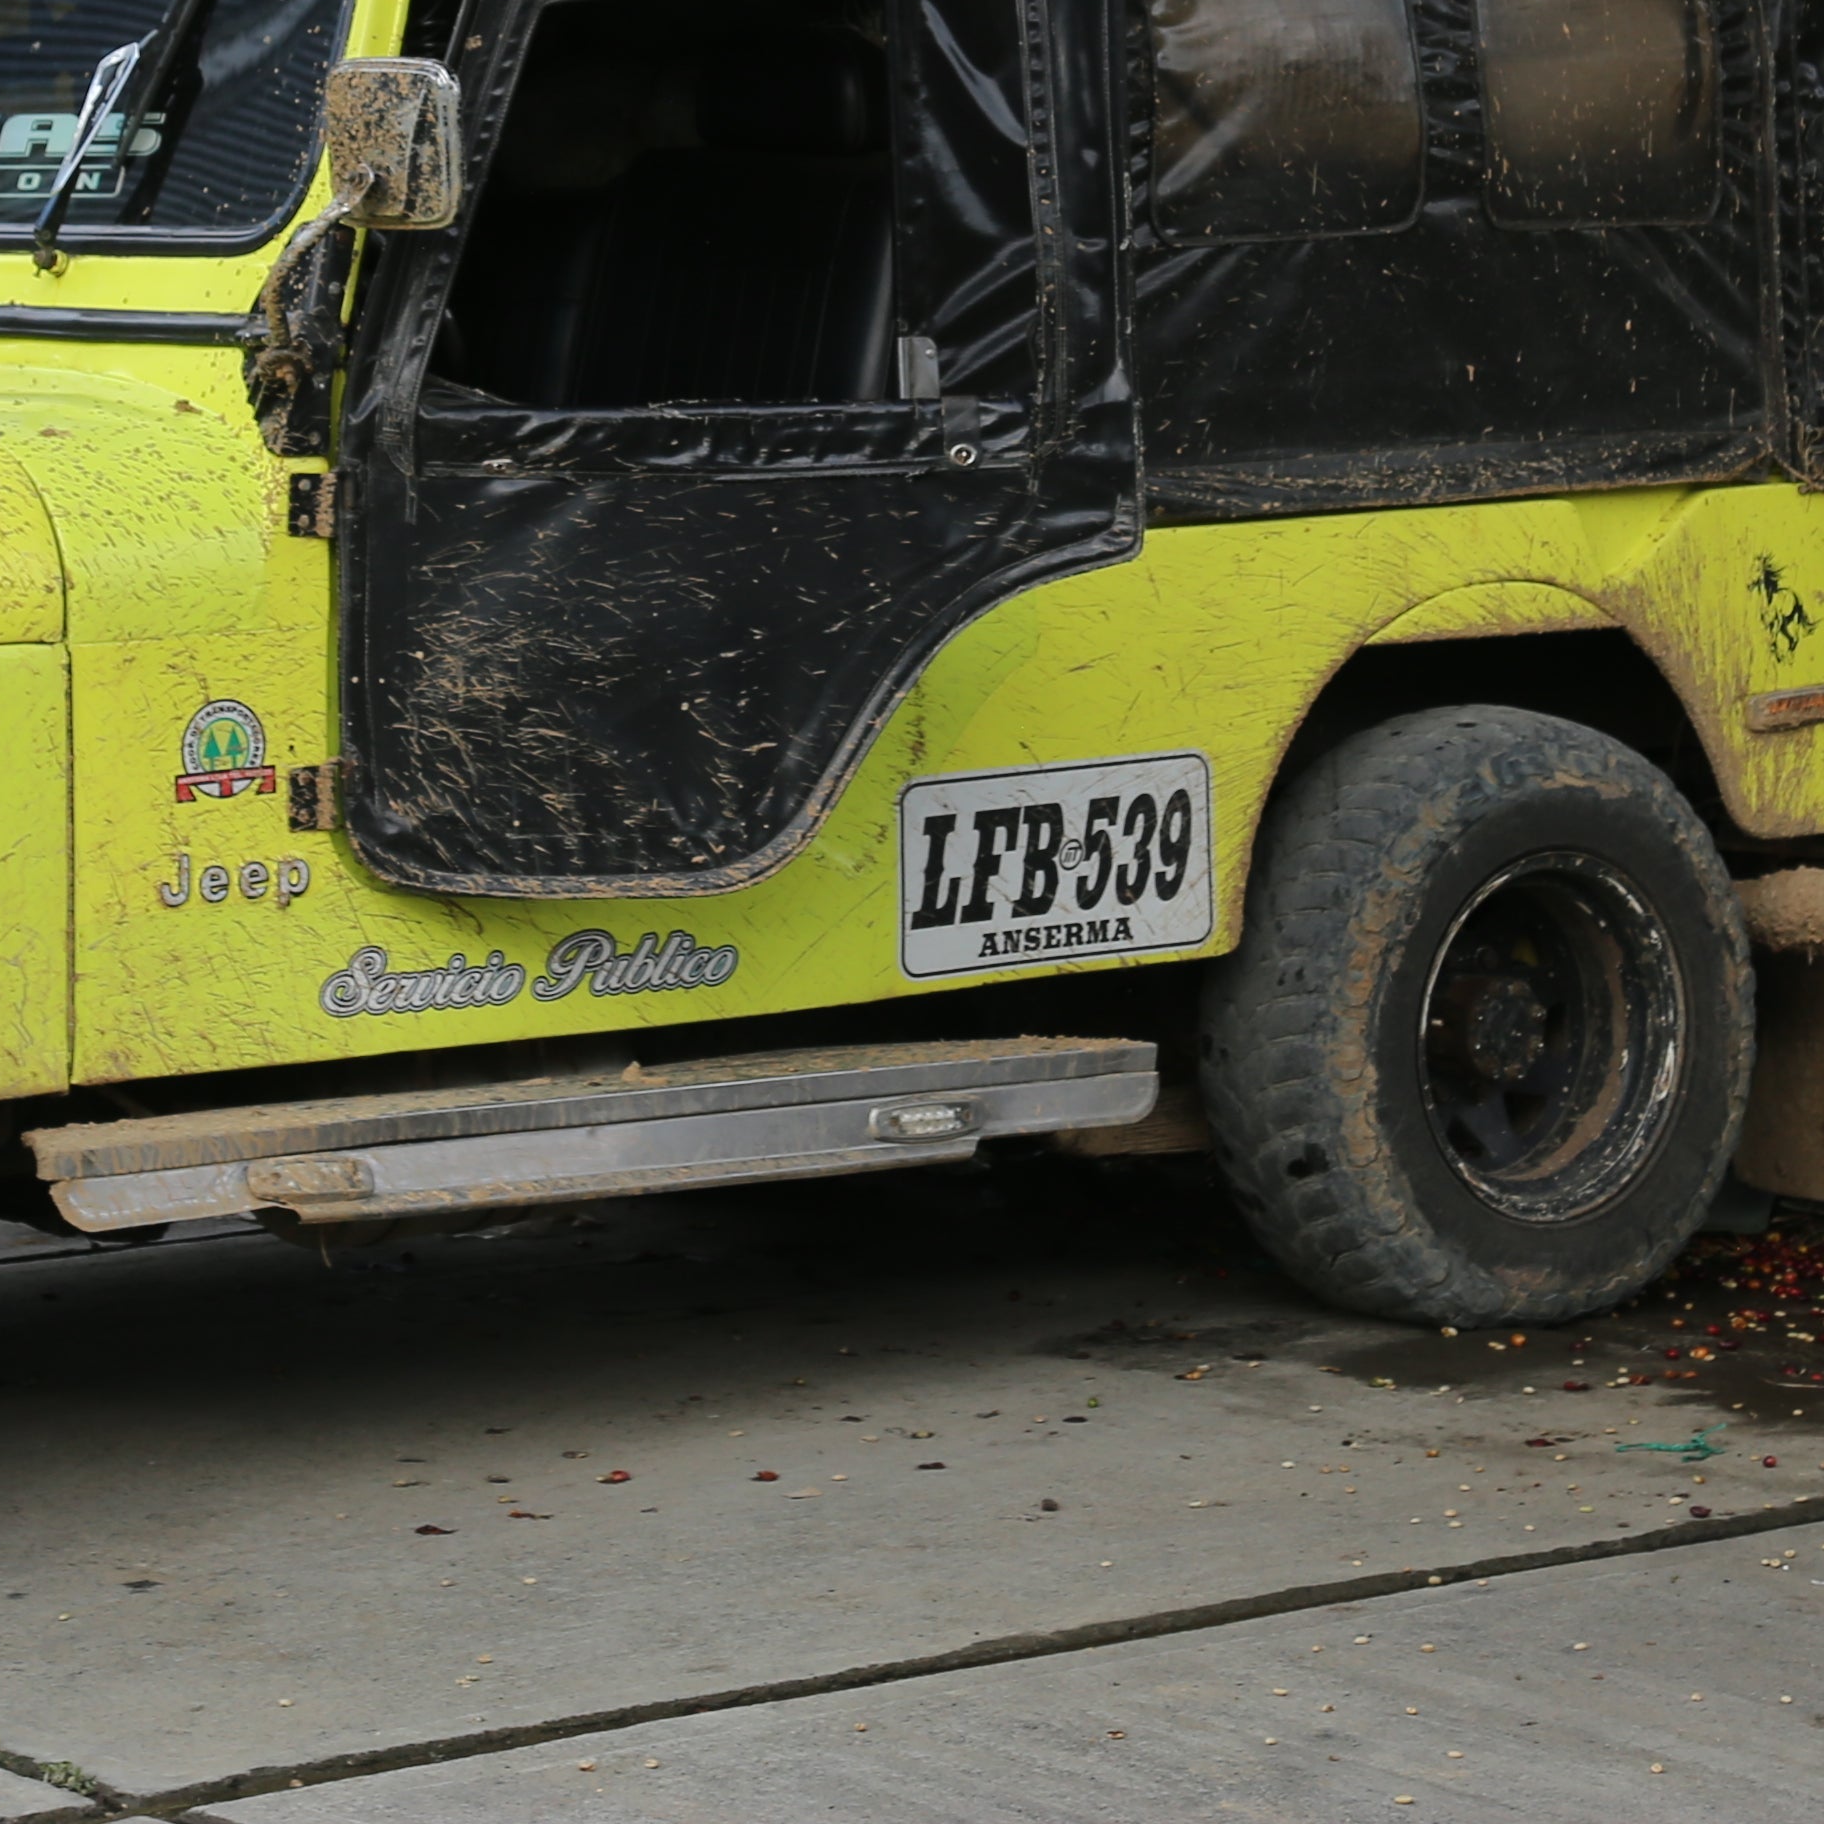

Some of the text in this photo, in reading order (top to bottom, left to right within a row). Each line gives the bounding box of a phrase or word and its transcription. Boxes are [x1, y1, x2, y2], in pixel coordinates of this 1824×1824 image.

[160, 853, 310, 908] Jeep
[911, 788, 1192, 930] LFB 539
[320, 928, 738, 1017] Servicio Publico
[978, 917, 1134, 958] ANSERMA
